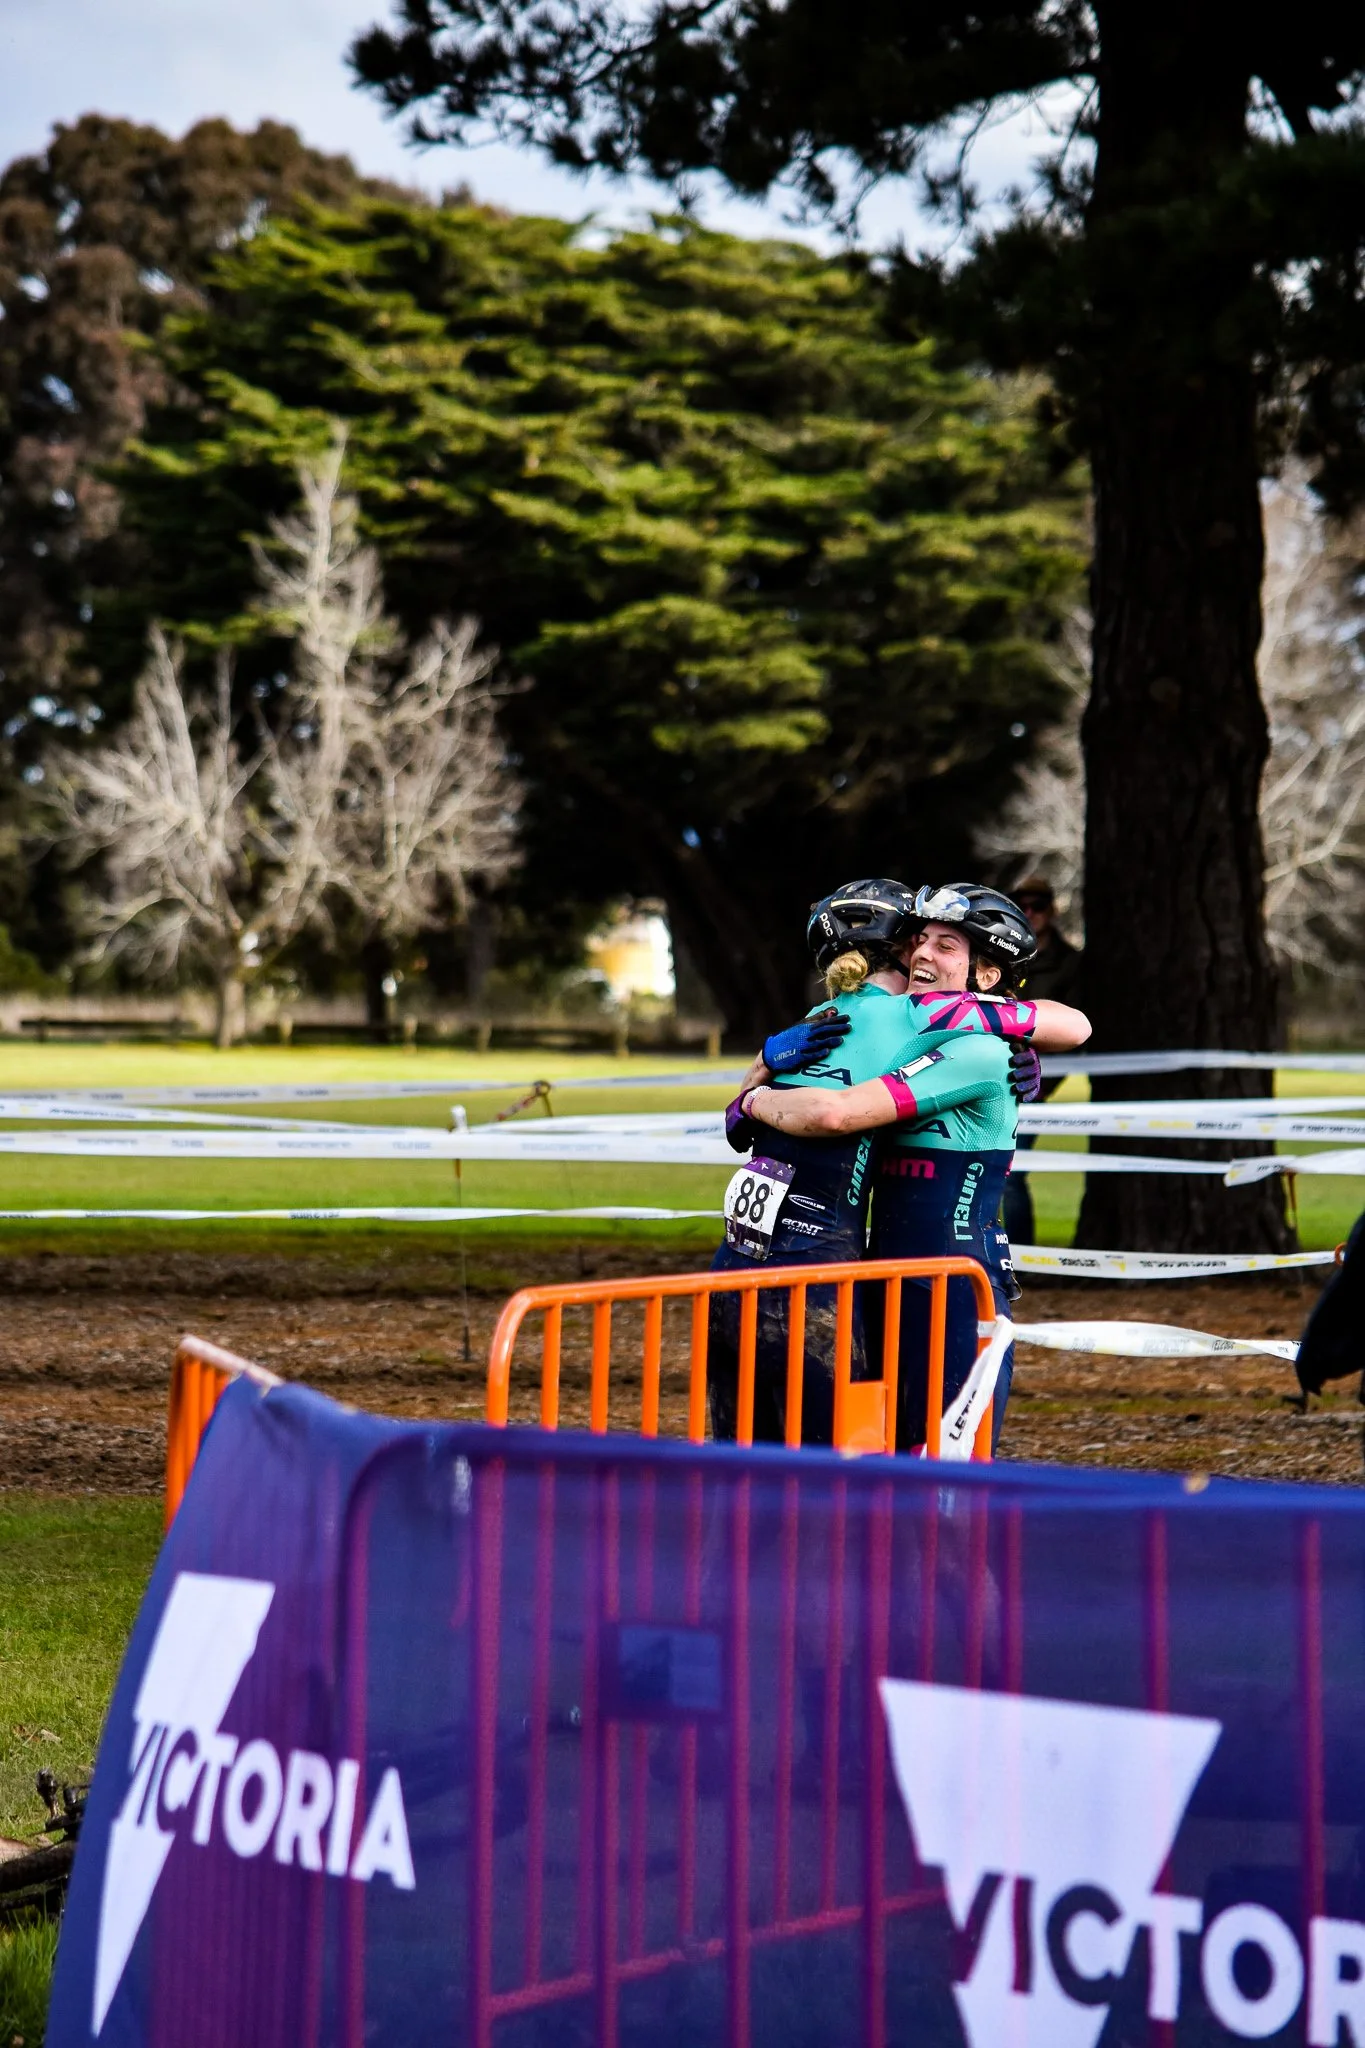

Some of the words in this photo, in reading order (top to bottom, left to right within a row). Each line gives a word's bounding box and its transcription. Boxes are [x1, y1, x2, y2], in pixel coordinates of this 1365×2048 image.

[819, 912, 834, 937] POC
[996, 937, 1021, 956] Hosking
[734, 1177, 770, 1224] 88
[781, 1218, 824, 1234] BONT
[115, 1716, 417, 1891] VICTORIA
